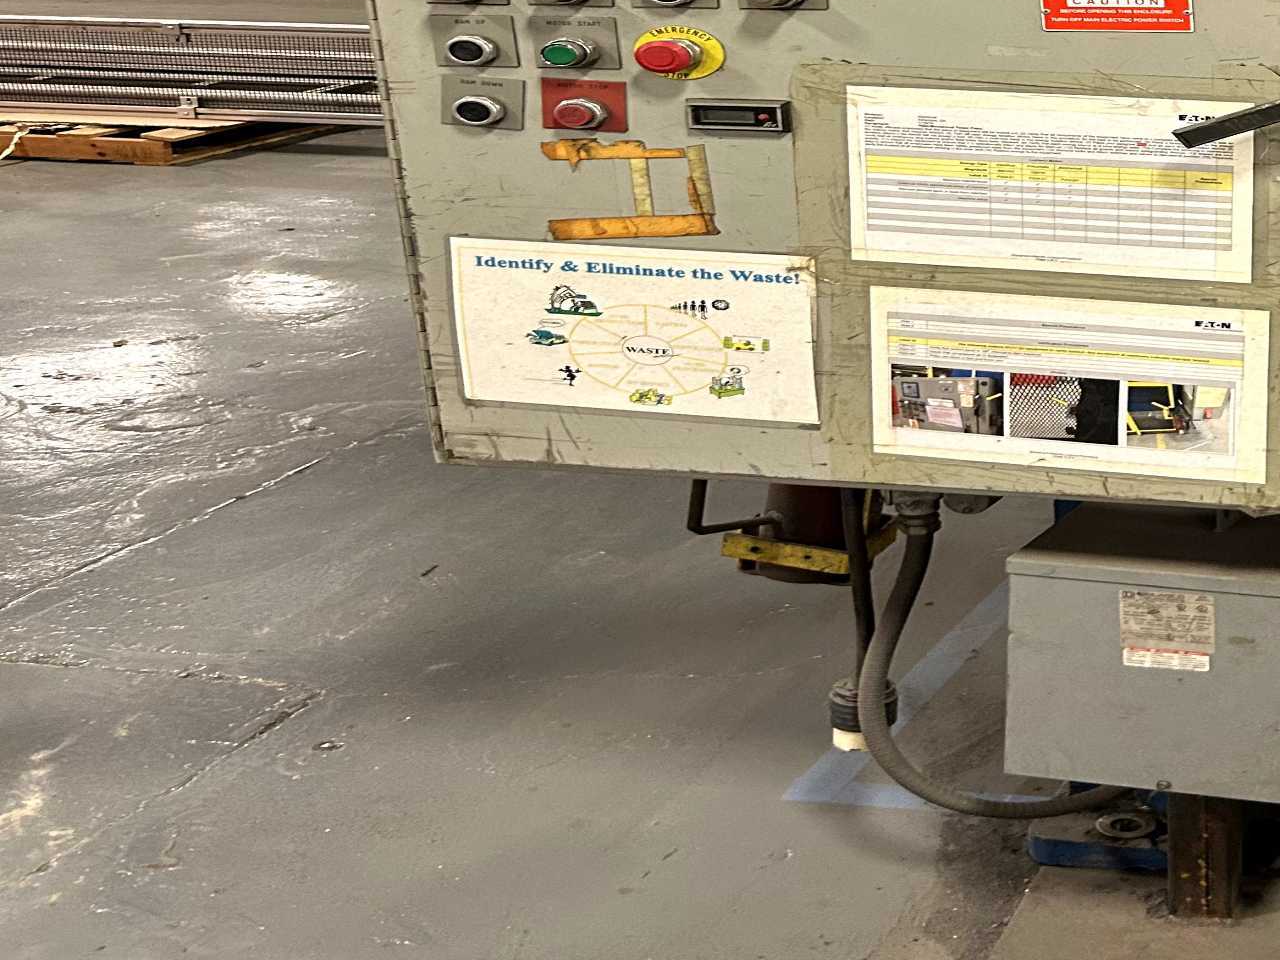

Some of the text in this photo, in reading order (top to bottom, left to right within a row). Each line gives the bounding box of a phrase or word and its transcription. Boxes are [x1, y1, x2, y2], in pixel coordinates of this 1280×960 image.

[649, 26, 714, 42] EMERGENCY
[475, 255, 801, 285] Identify & Eliminate the Waste!
[625, 346, 671, 355] WASTE
